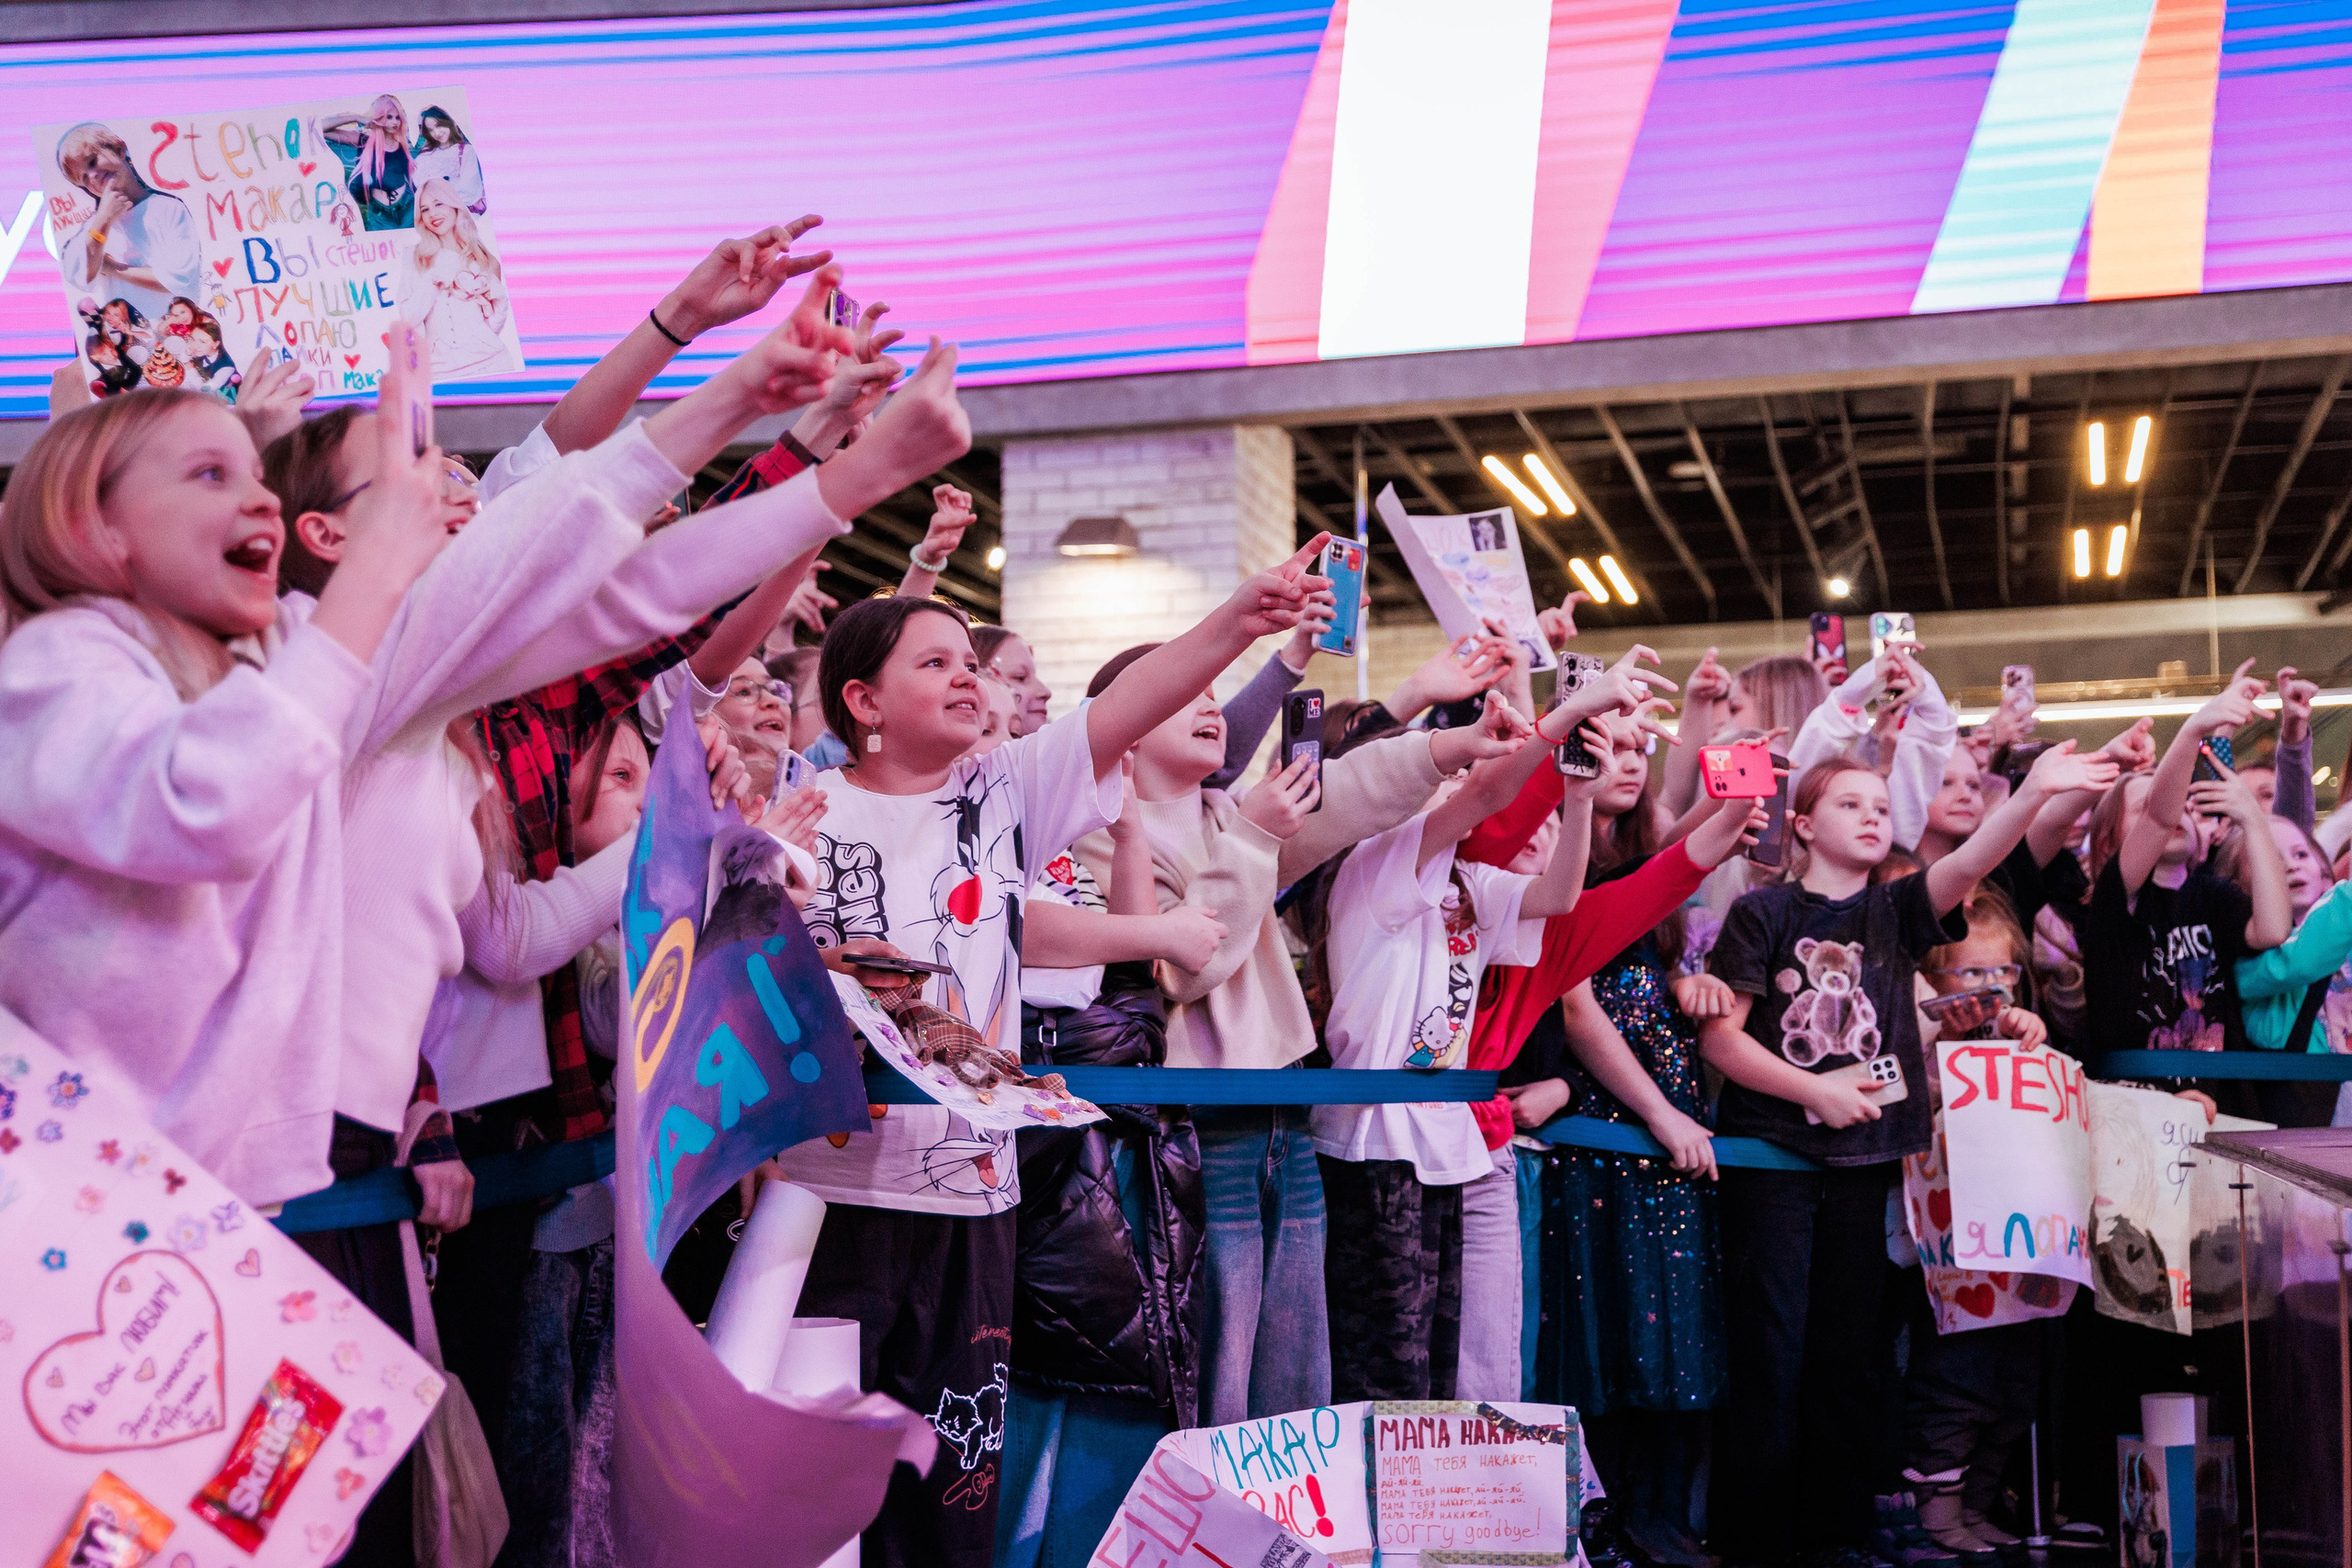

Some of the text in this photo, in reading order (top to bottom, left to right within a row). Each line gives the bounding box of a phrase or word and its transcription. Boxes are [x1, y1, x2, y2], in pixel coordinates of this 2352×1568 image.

[233, 272, 394, 324] ЛУЧШИЕ
[255, 317, 357, 349] ЛОПАЮ
[1209, 1405, 1340, 1490] МАКАР
[1380, 1416, 1451, 1451] МАМА
[1382, 1456, 1421, 1475] МАМА
[1464, 1507, 1542, 1545] goodbye!
